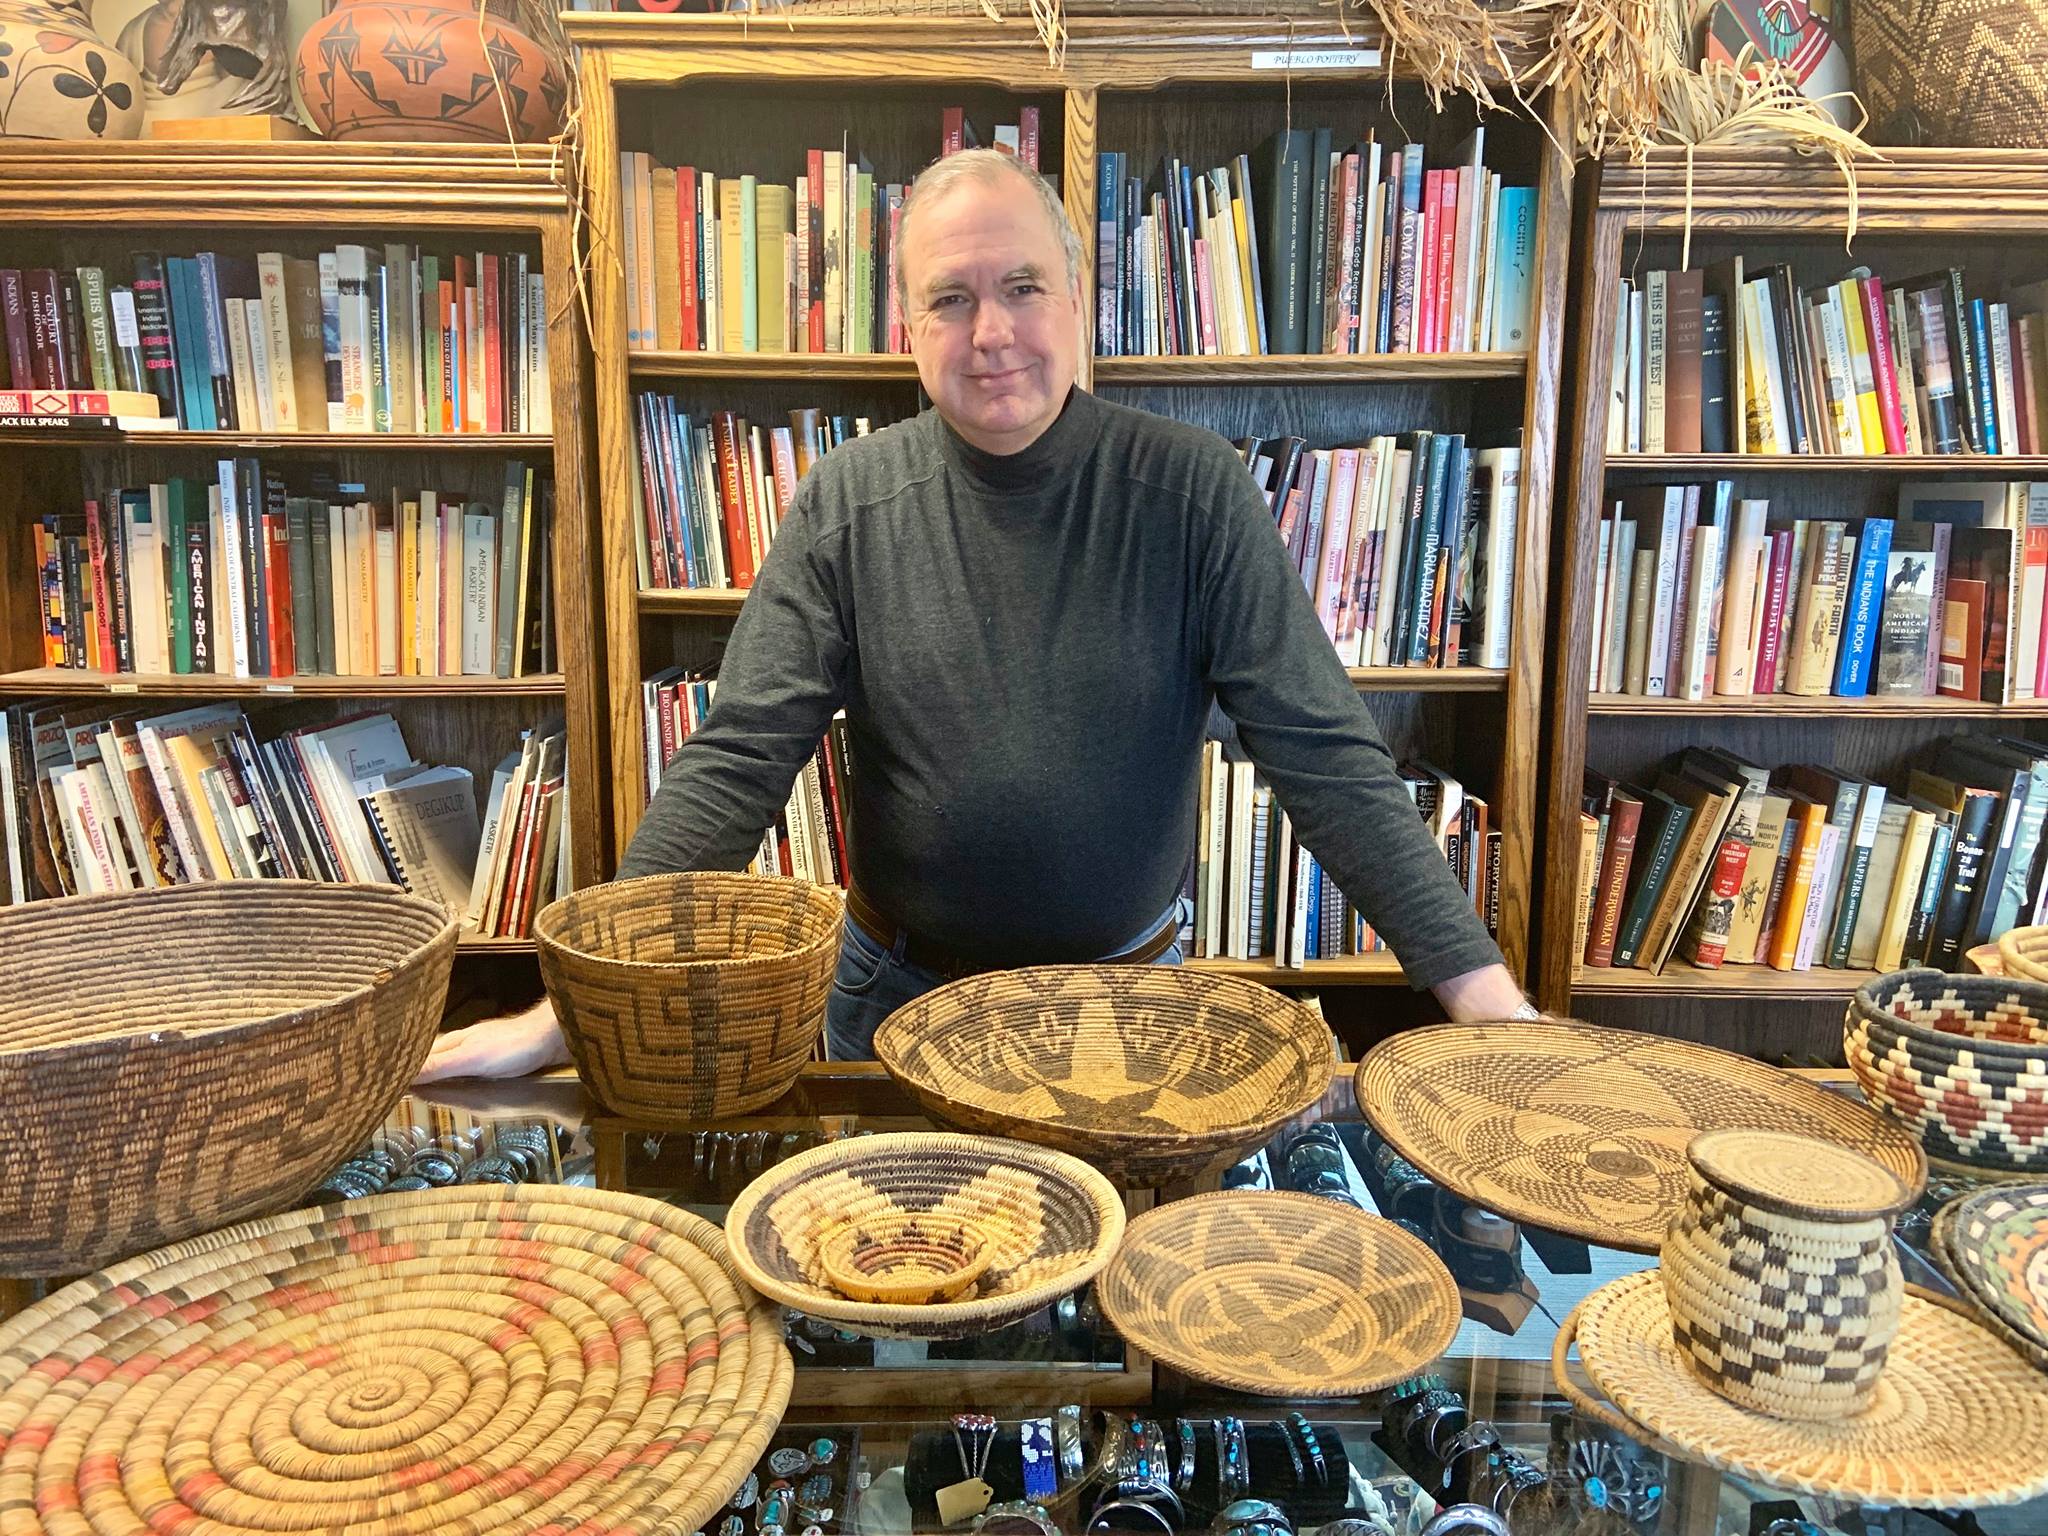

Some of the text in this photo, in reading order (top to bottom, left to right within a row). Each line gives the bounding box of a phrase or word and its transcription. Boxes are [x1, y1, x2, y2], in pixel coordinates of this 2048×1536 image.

[1274, 53, 1360, 64] PUEBLO POTTERY
[1328, 226, 1336, 262] POTTERY
[1401, 207, 1415, 260] ACOMA
[1353, 247, 1361, 267] Gods
[6, 276, 19, 315] INDIANS
[1326, 264, 1334, 297] DESIGNS
[1351, 271, 1359, 305] Reigned
[31, 291, 44, 349] DISHONOR
[45, 294, 57, 344] CENTURY
[86, 271, 106, 353] SPURS WEST
[1651, 283, 1663, 386] THIS IS THE WEST
[1961, 322, 1969, 351] NATIONAL
[372, 336, 382, 386] APACHES
[38, 418, 69, 426] SPEAKS
[722, 422, 738, 504] INDIAN TRADER
[1413, 486, 1423, 519] MARIA
[1430, 493, 1441, 522] Tradition
[2016, 491, 2025, 535] AMERICAN
[1430, 523, 1437, 532] of
[228, 556, 235, 565] OF
[1424, 534, 1439, 577] MARIA
[1865, 560, 1877, 578] THE
[89, 523, 106, 628] CULTURAL ANTHROPOLOGY
[477, 549, 486, 622] AMERICAN INDIAN
[192, 549, 206, 656] AMERICAN INDIAN
[1417, 579, 1433, 640] MARTINEZ
[1853, 624, 1866, 652] BOOK
[1851, 660, 1859, 683] DOVER
[662, 694, 672, 744] RIO GRANDE
[79, 782, 105, 861] AMERICAN INDIAN
[813, 802, 825, 838] WEAVING
[1663, 810, 1682, 845] PATTERN
[1703, 801, 1717, 829] INDIAN
[485, 820, 497, 855] BASKETRY
[1688, 850, 1696, 858] OF
[1694, 833, 1704, 845] ART
[1721, 849, 1746, 857] AMERICAN
[1967, 833, 1977, 841] The
[1449, 838, 1457, 871] CANVAS
[1679, 864, 1691, 878] THE
[1958, 865, 1977, 878] Trail
[1960, 856, 1971, 864] za
[1490, 842, 1500, 929] STORYTELLER
[1851, 850, 1868, 898] TRAPPERS
[1600, 855, 1626, 946] THUNDERWOMAN
[1665, 881, 1682, 908] UNITED
